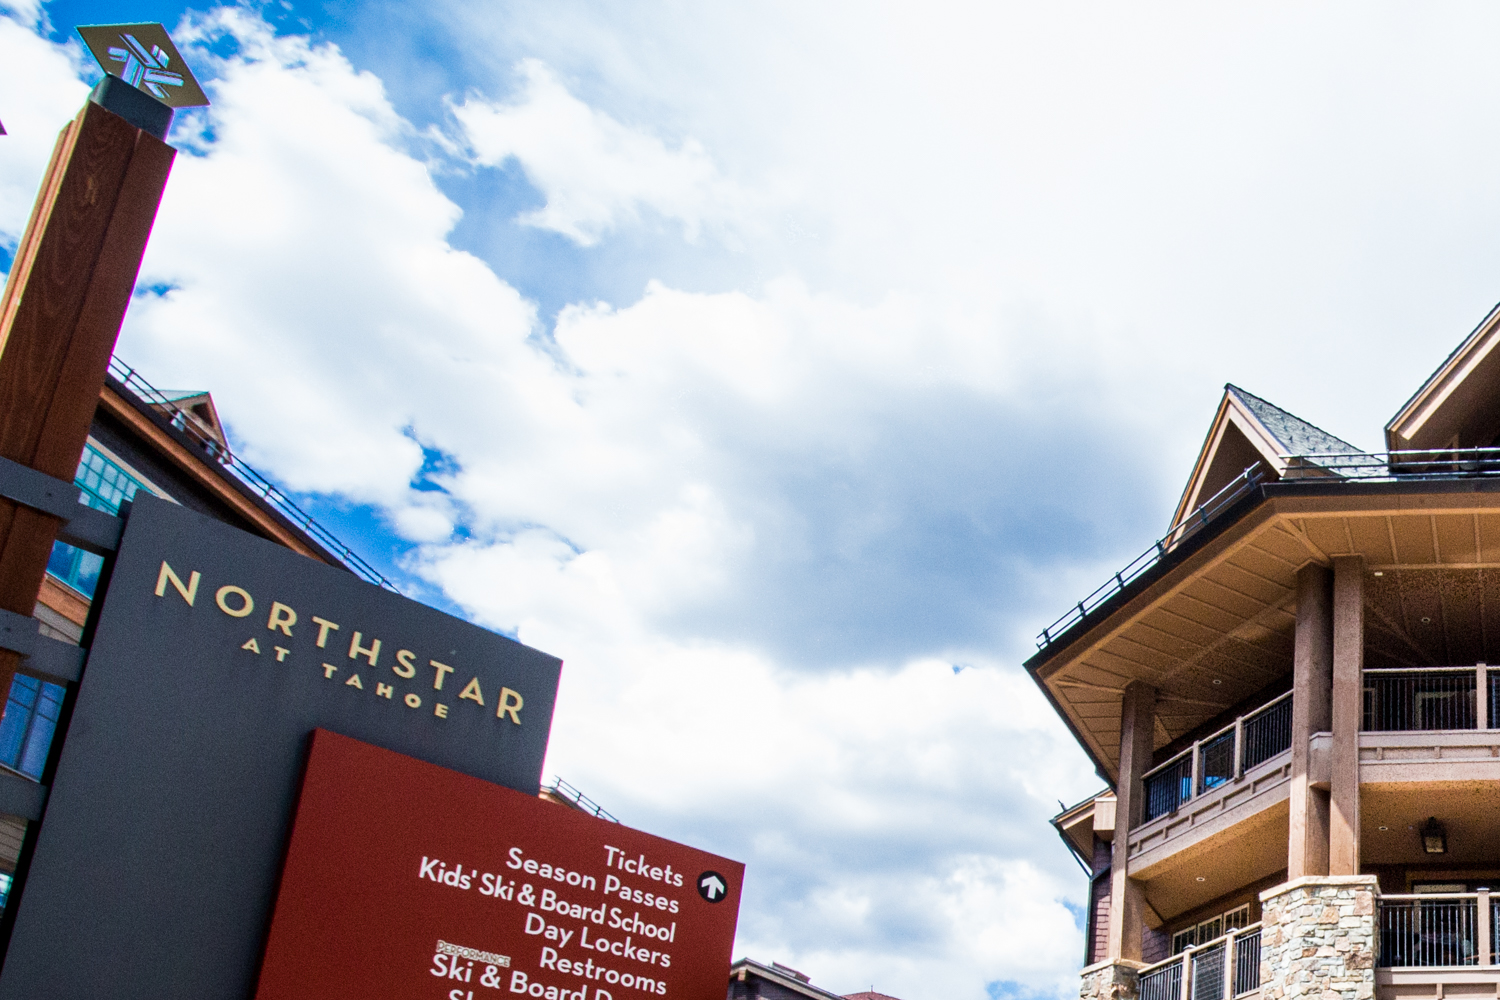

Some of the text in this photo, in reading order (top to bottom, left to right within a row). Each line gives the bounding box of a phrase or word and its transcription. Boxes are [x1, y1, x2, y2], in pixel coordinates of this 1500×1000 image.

[155, 561, 524, 725] NORTHSTAR
[241, 637, 449, 719] AT TAHOE
[506, 847, 680, 914] Season Passes
[603, 844, 684, 887] Tickets
[418, 856, 676, 943] Kids' Ski & Board School
[436, 940, 511, 968] PERFORMANCE
[524, 912, 671, 968] Day Lockers
[429, 953, 474, 983] Ski
[480, 965, 500, 989] &
[540, 946, 667, 995] Restrooms
